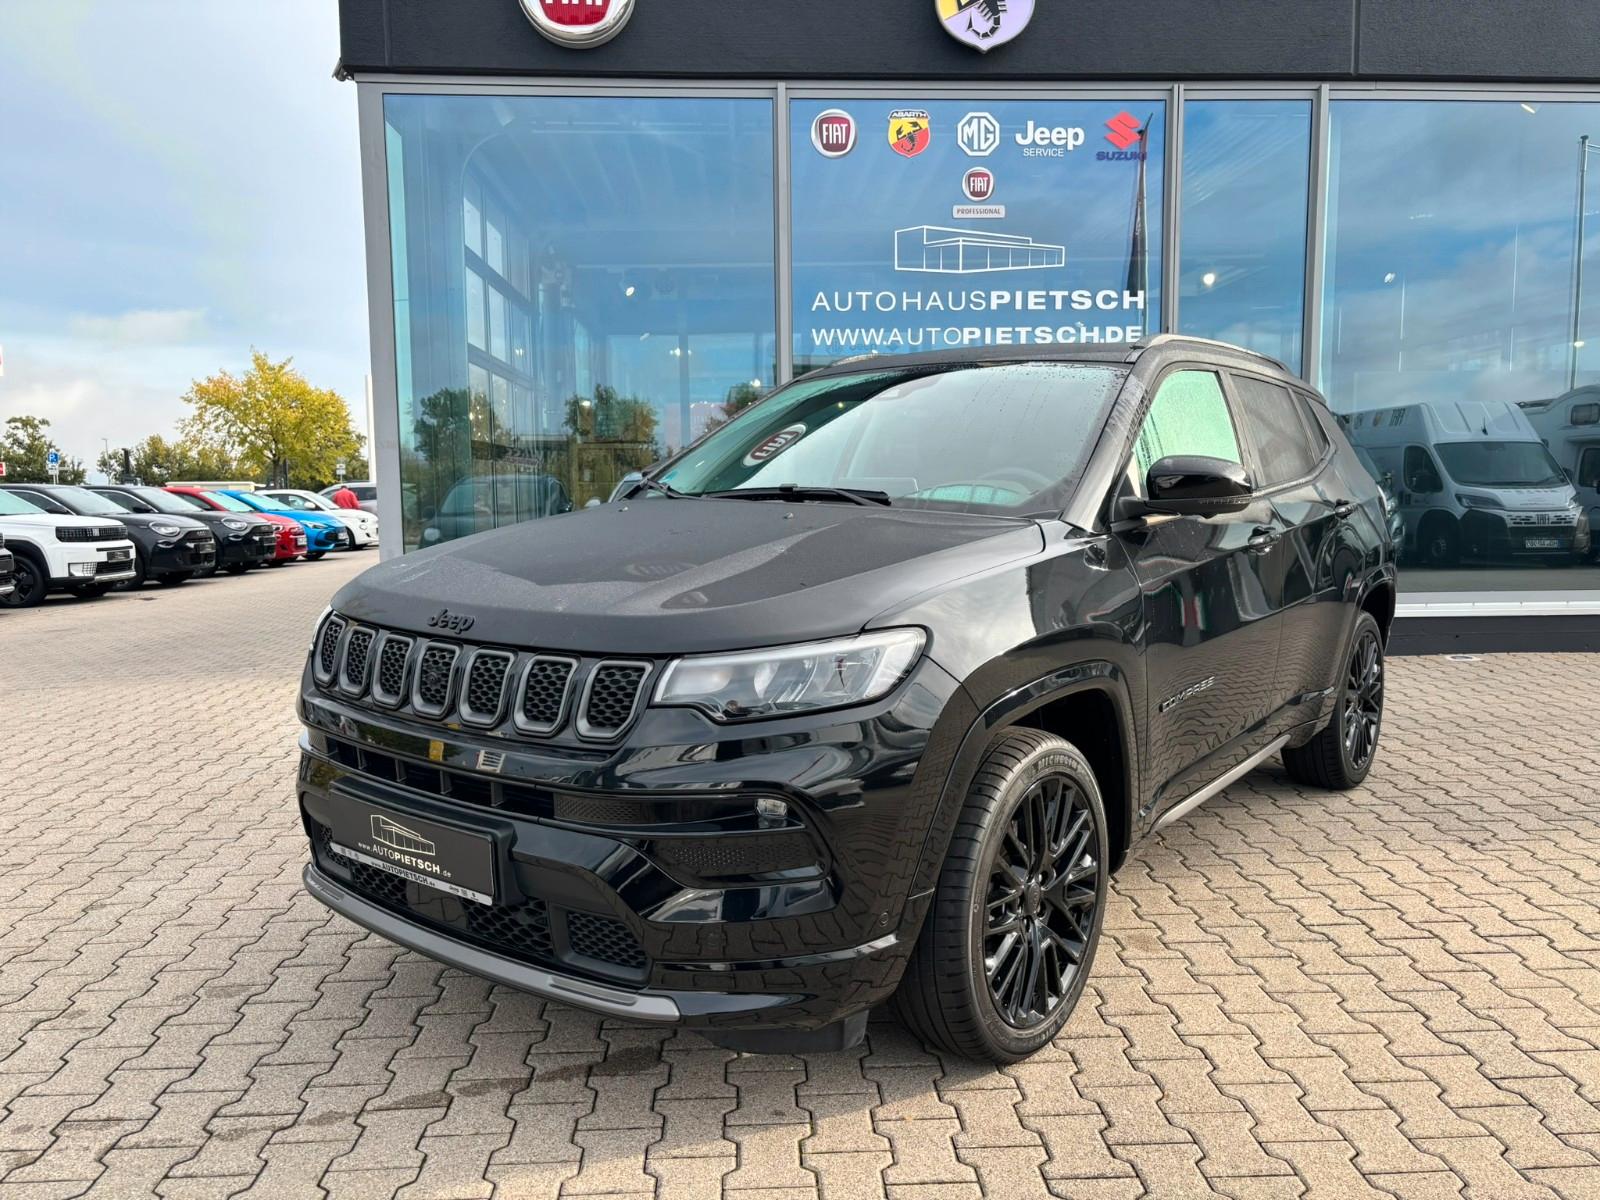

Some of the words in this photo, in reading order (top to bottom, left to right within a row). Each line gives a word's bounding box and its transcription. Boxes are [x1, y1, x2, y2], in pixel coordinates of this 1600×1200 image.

[822, 123, 848, 144] FIAT
[962, 117, 995, 151] MG
[1015, 120, 1085, 150] Jeep
[1023, 148, 1064, 157] SERVICE
[1096, 151, 1147, 161] SUZUKI
[970, 176, 988, 192] FIAT
[956, 207, 1001, 215] PROFESSIONAL
[811, 326, 1143, 346] WWW.AUTOPIETSCH.DE
[427, 608, 476, 635] Jeep
